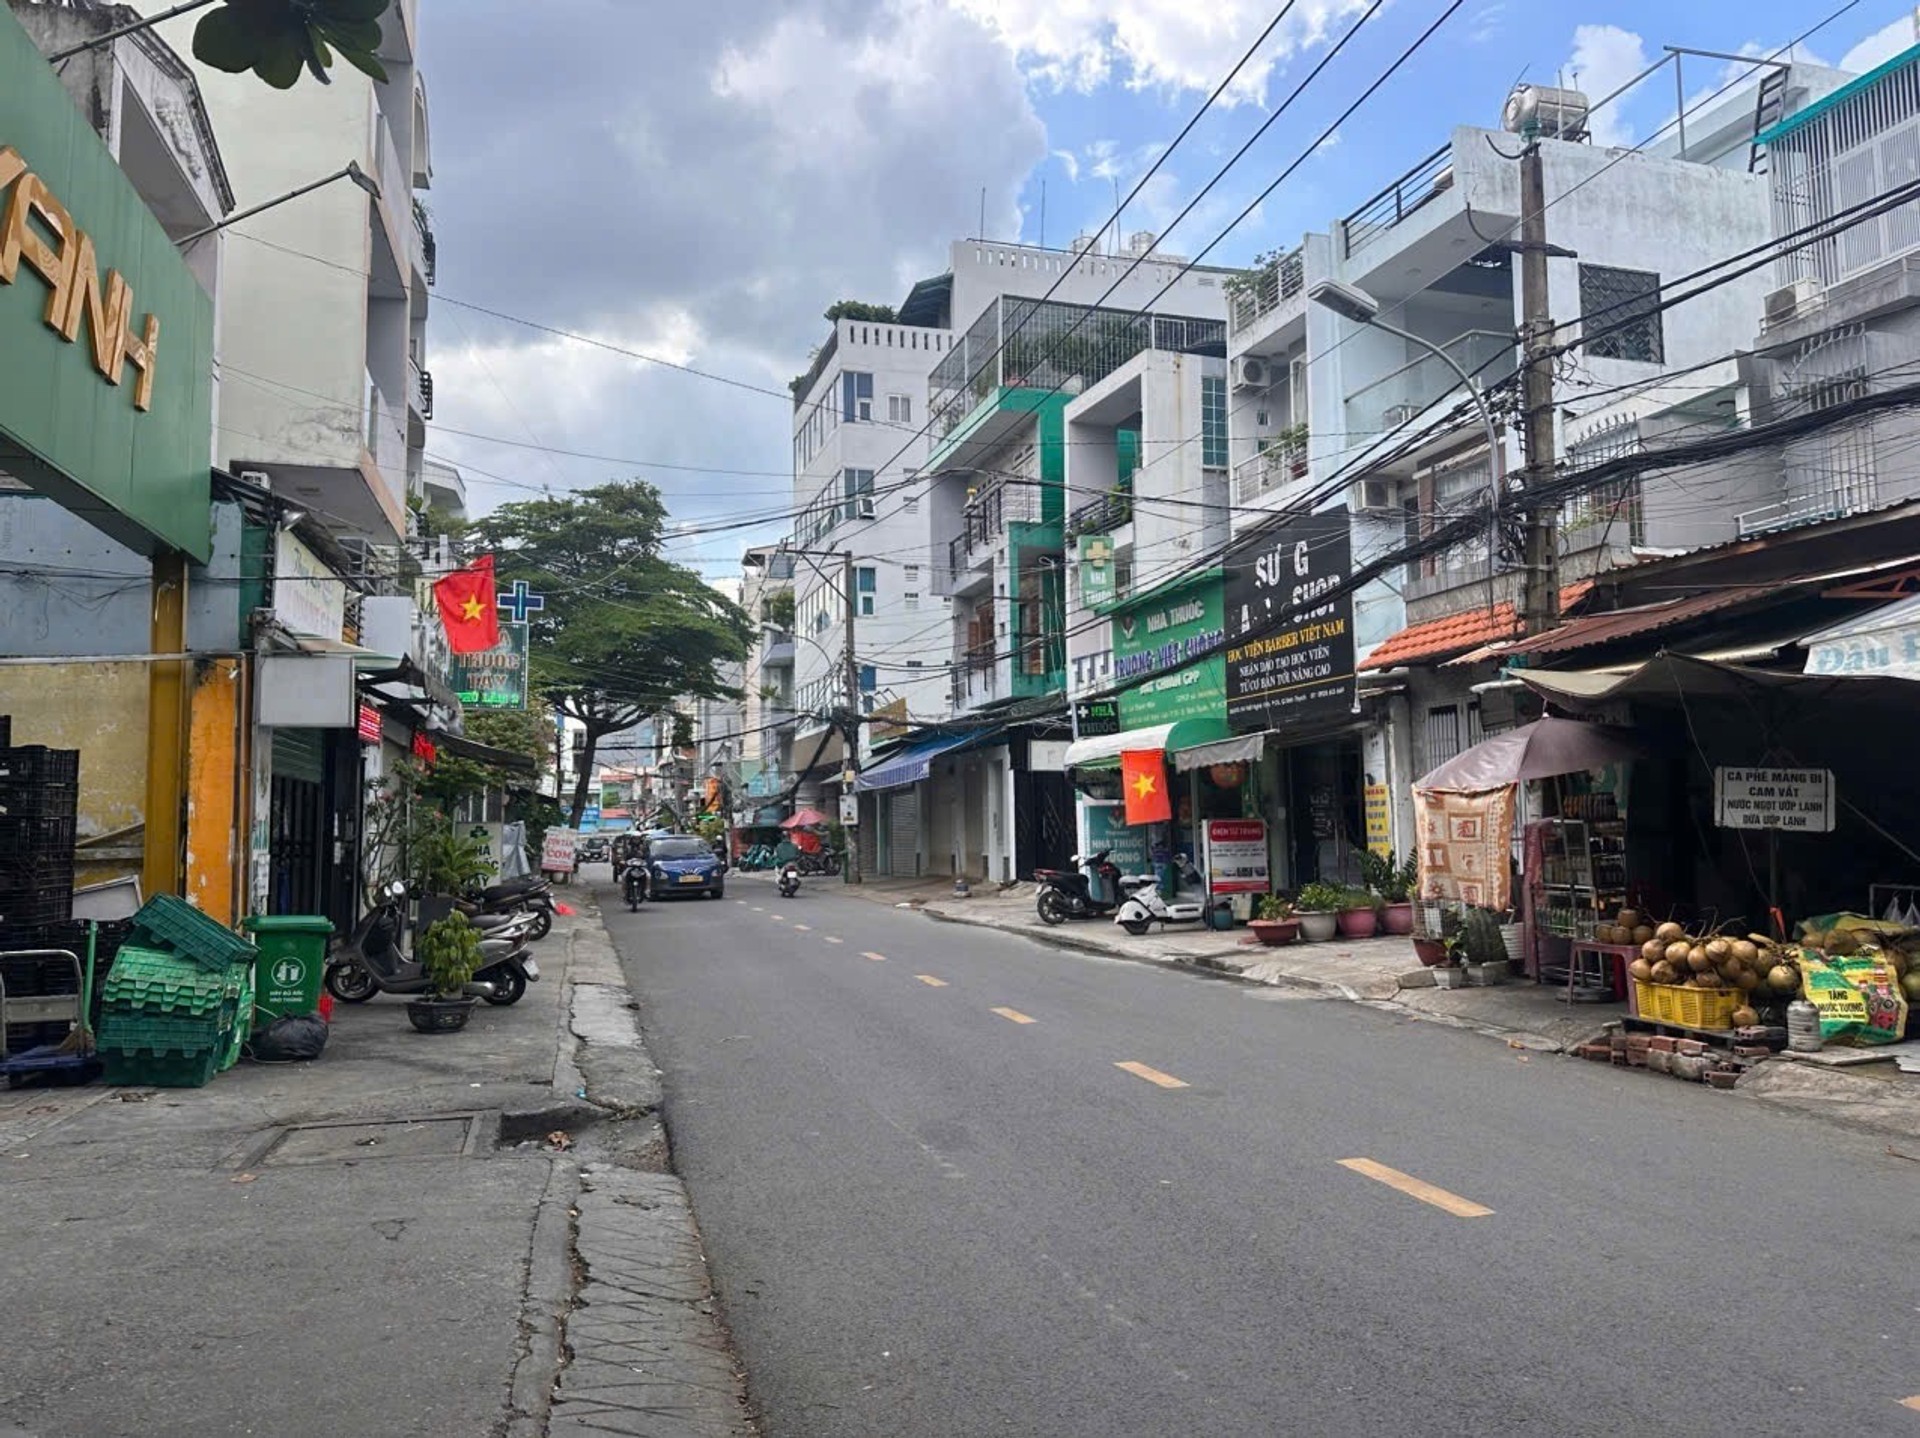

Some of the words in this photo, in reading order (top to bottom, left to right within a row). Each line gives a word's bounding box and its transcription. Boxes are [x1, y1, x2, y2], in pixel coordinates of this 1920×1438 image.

[0, 145, 160, 412] ANH
[1147, 610, 1168, 633] NHÀ
[1170, 599, 1205, 626] THUỐC
[1244, 639, 1265, 659] VIỆN
[1265, 632, 1299, 653] BARBER
[1299, 622, 1321, 644] VIỆT
[1322, 619, 1345, 638] NAM
[1239, 662, 1260, 677] NHẬN
[1308, 644, 1331, 661] VIÊN
[1315, 663, 1331, 676] CAO
[1817, 641, 1890, 673] Đậu
[1091, 702, 1115, 717] NHÀ
[1746, 771, 1768, 783] PHÊ
[1771, 773, 1807, 784] MANG
[1749, 787, 1775, 797] CAM
